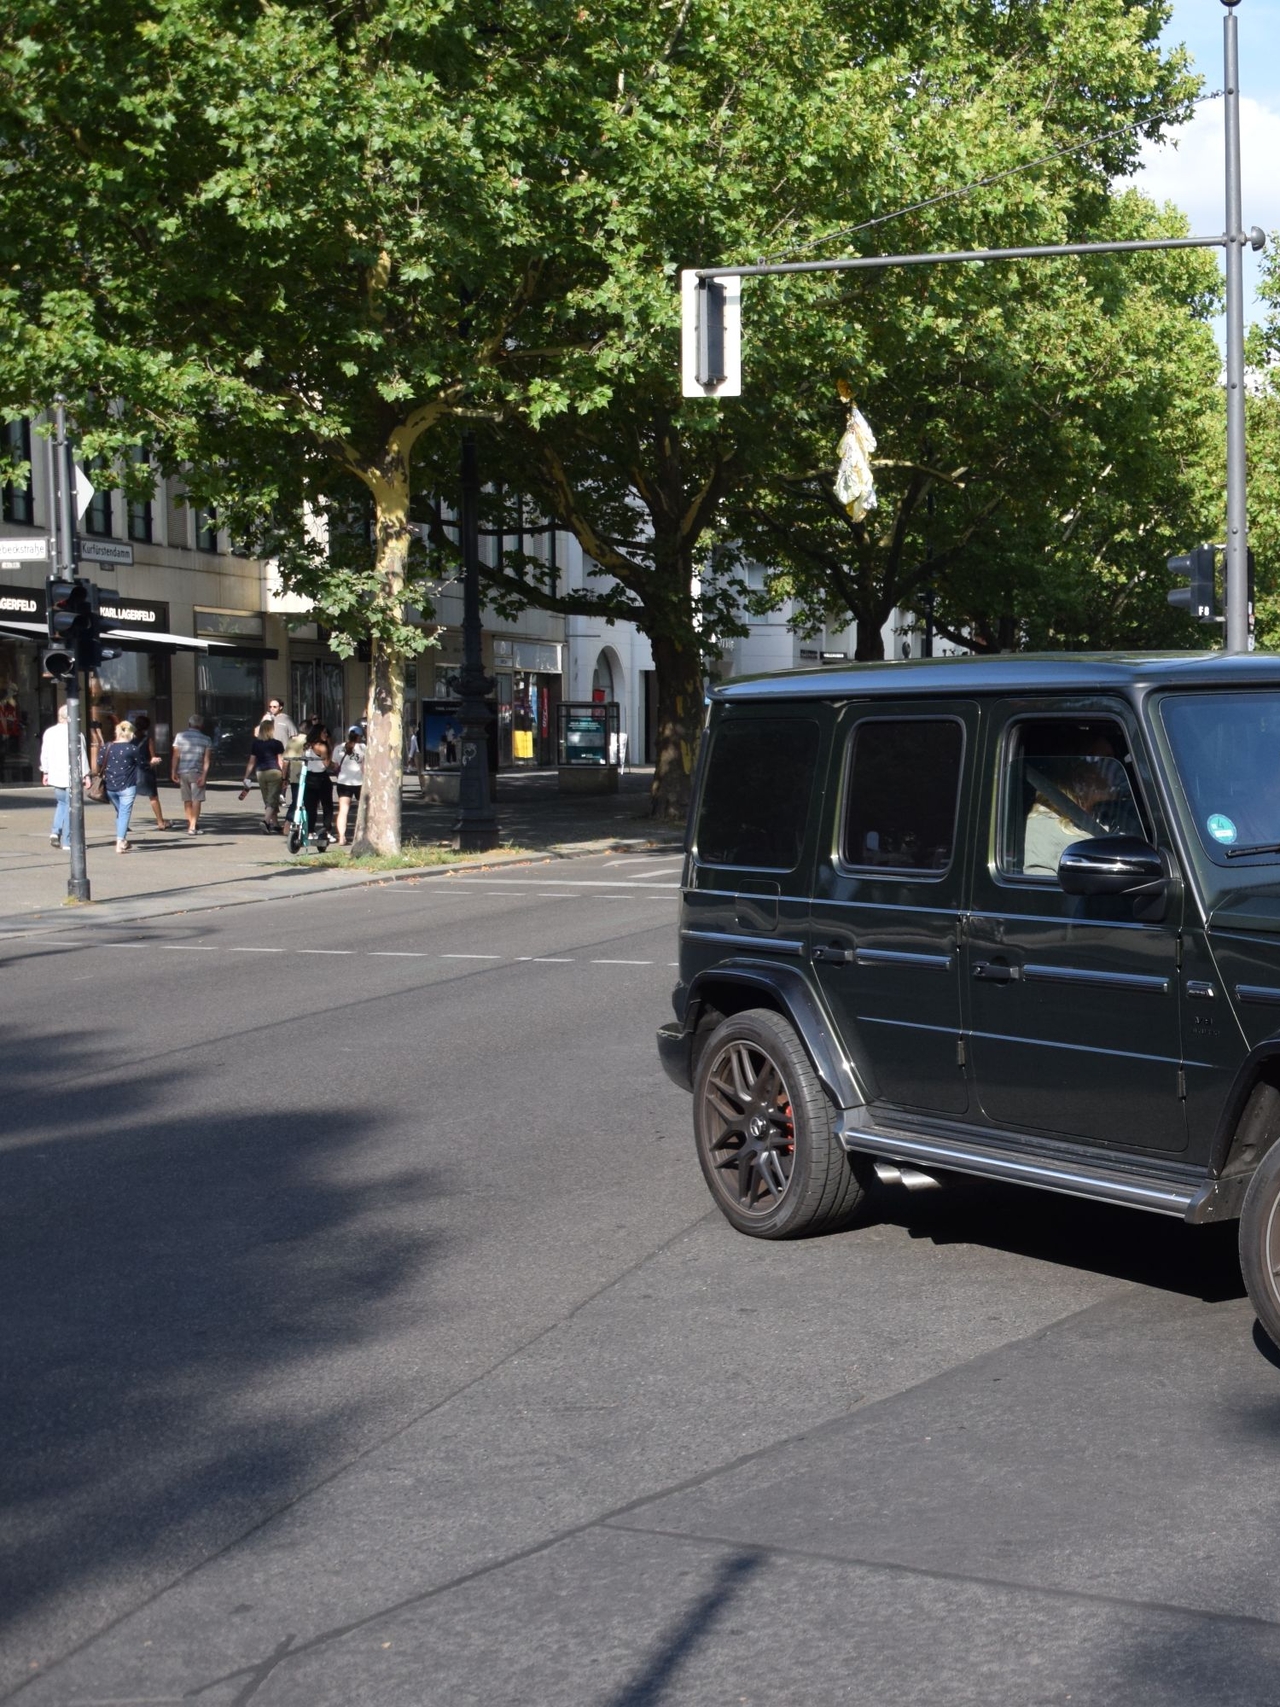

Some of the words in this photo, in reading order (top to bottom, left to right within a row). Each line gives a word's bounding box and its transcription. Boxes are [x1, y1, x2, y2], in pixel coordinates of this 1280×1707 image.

[82, 544, 131, 559] Kurfürstendamm
[100, 606, 118, 618] KARL
[118, 607, 156, 622] LAGERFELD
